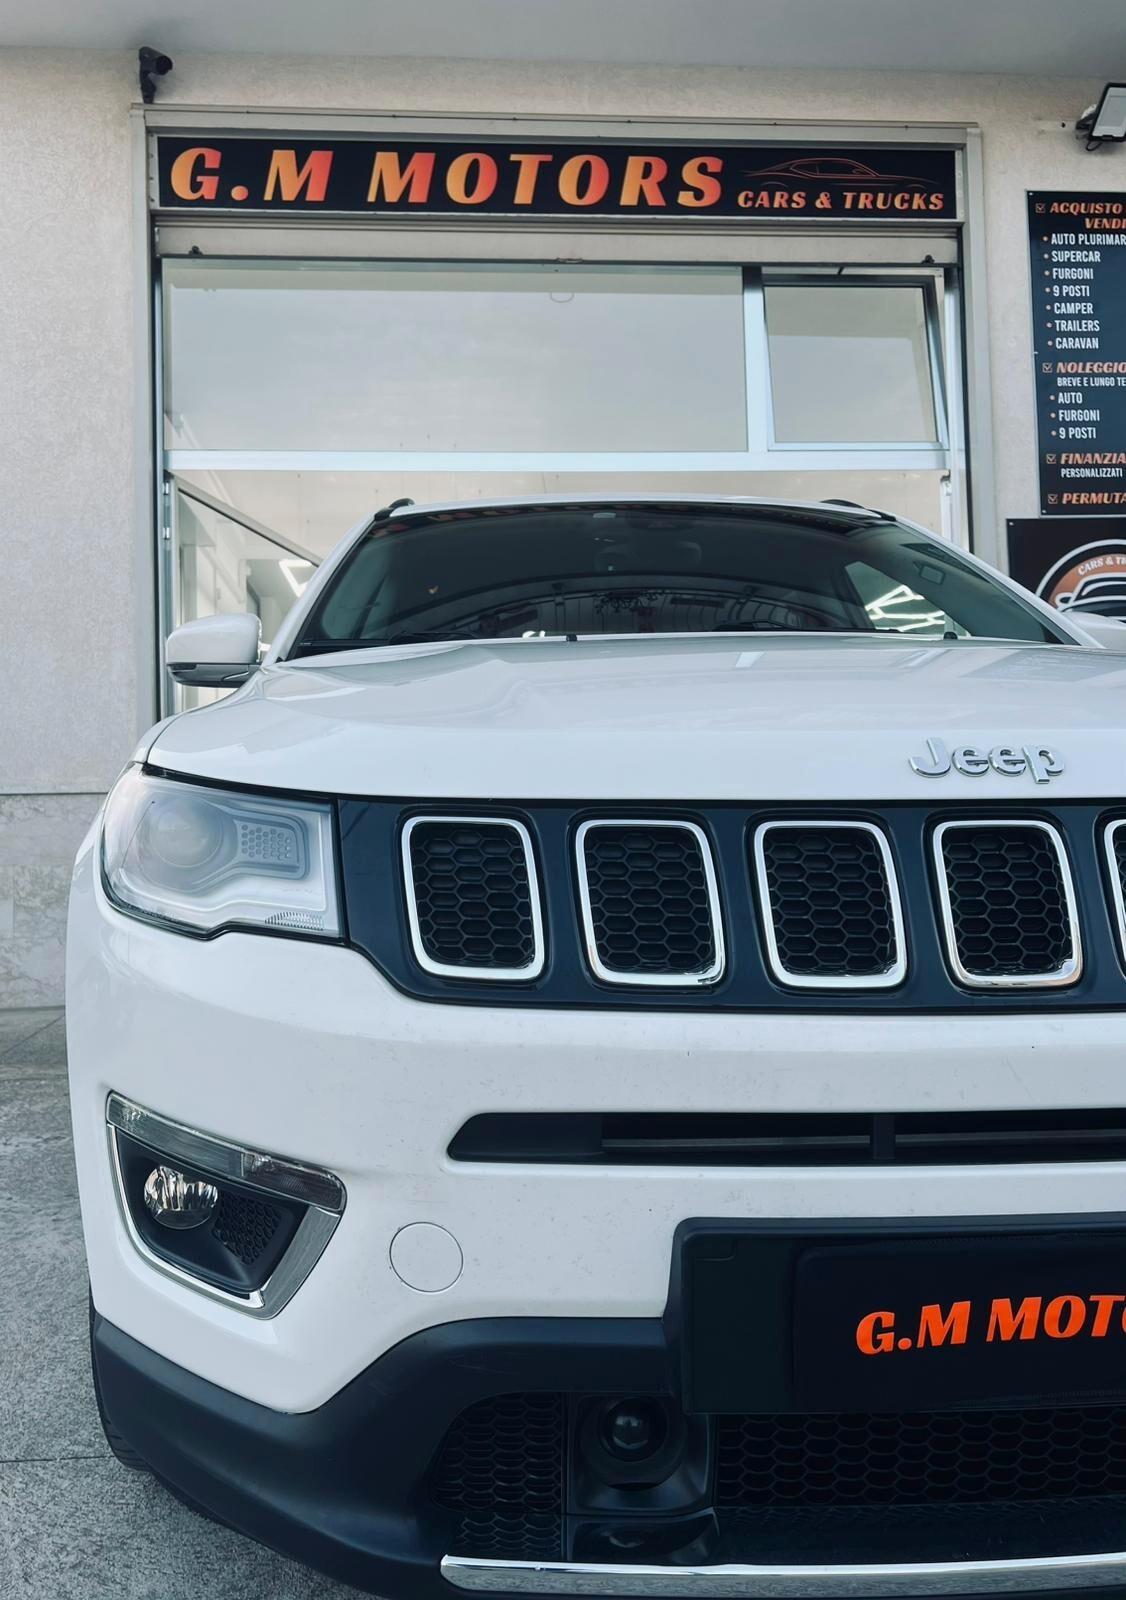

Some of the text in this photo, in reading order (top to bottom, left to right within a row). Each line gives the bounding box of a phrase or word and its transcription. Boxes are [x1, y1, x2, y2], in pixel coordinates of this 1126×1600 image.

[170, 147, 724, 208] G.M MOTORS
[737, 190, 944, 210] CARS & TRUCKS
[1050, 202, 1122, 214] ACQUISTO
[1051, 233, 1126, 245] AUTO PLURIMAR
[1051, 251, 1101, 262] SUPERCAR
[1052, 268, 1094, 280] FURGONI
[1053, 285, 1090, 297] 9 POSTI
[1054, 302, 1094, 314] CAMPER
[1054, 320, 1100, 332] TRAILERS
[1055, 337, 1099, 349] CARAVAN
[1056, 362, 1126, 374] NOLEGGIO
[1057, 377, 1081, 387] BREVE
[1083, 377, 1088, 387] E
[1090, 377, 1115, 387] LUNGO
[1058, 392, 1083, 404] AUTO
[1058, 410, 1100, 421] FURGONI
[1059, 427, 1096, 439] 9 POSTI
[1060, 453, 1126, 465] FINANZIA
[1061, 468, 1123, 478] PERSONALIZZATI
[1078, 557, 1104, 575] CARS
[1105, 556, 1114, 566] &
[908, 737, 1065, 784] Jeep
[856, 1295, 1126, 1355] G.M MOT
